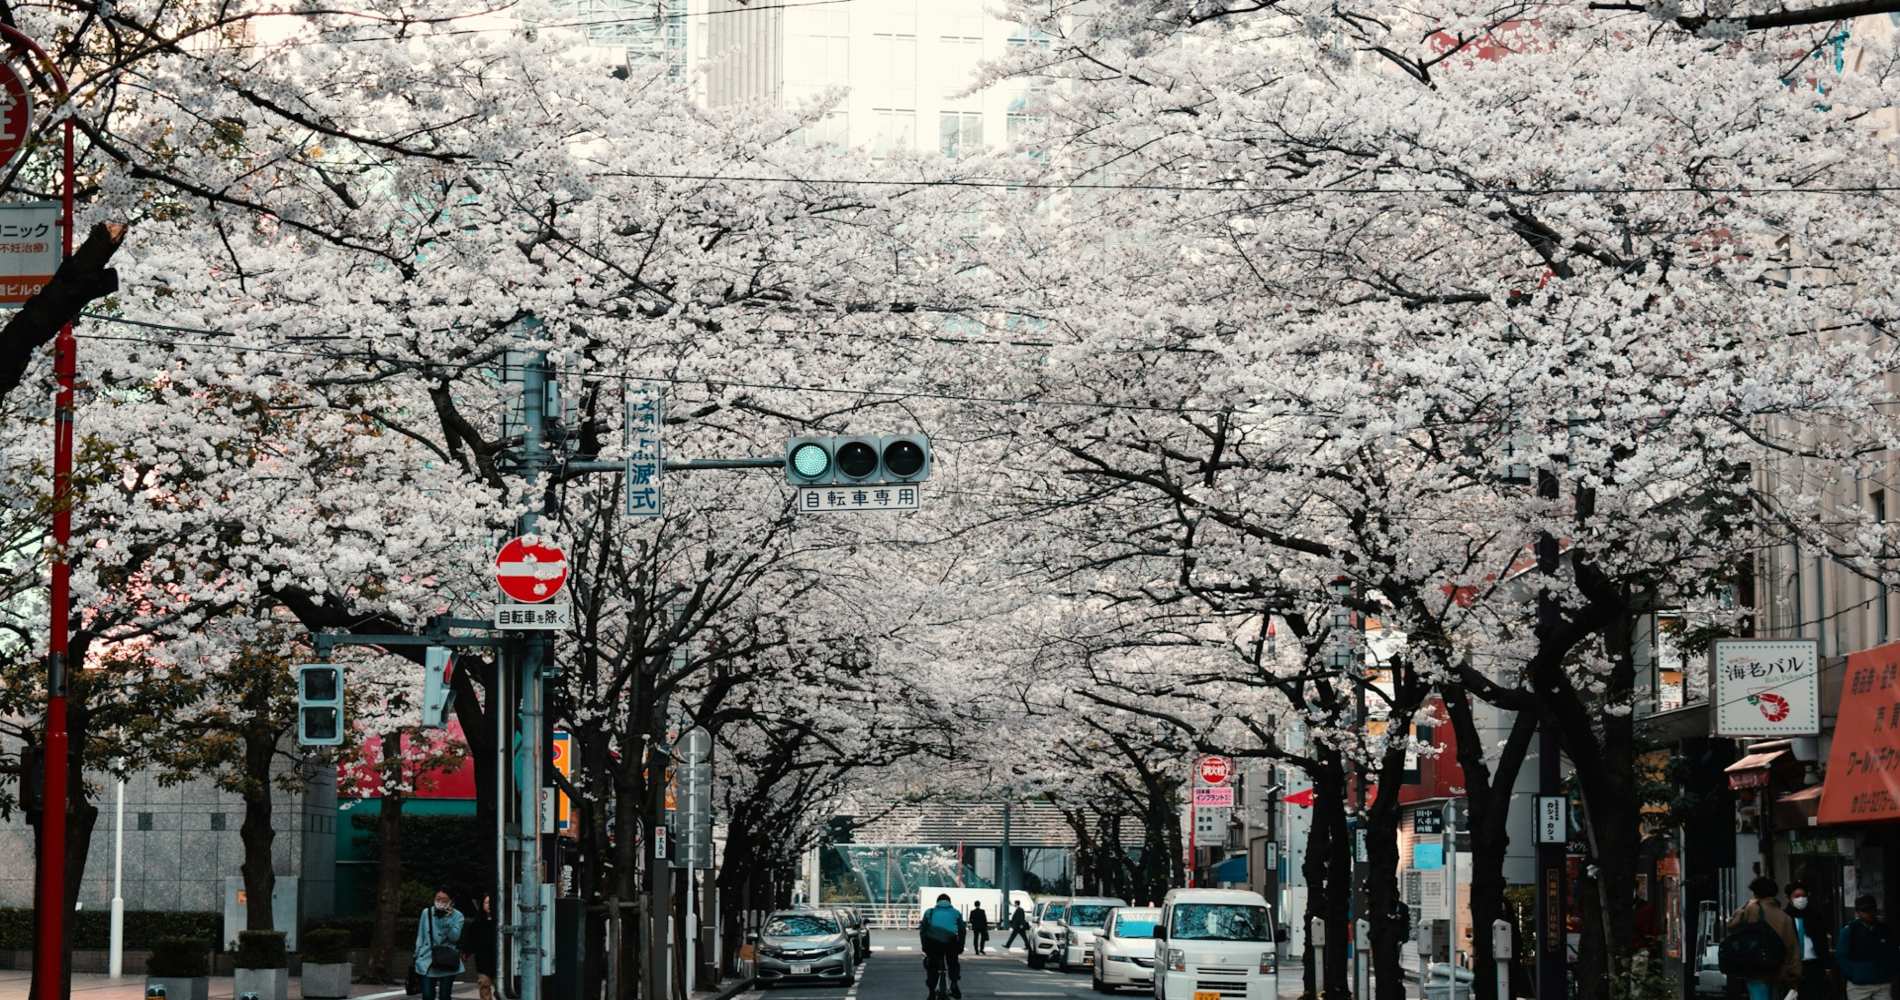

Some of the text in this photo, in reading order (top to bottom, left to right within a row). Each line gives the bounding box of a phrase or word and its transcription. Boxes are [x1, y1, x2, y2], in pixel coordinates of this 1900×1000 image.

[806, 488, 915, 508] 自転車専用
[499, 609, 566, 625] 自転車を除く
[1724, 656, 1805, 681] 海老バル
